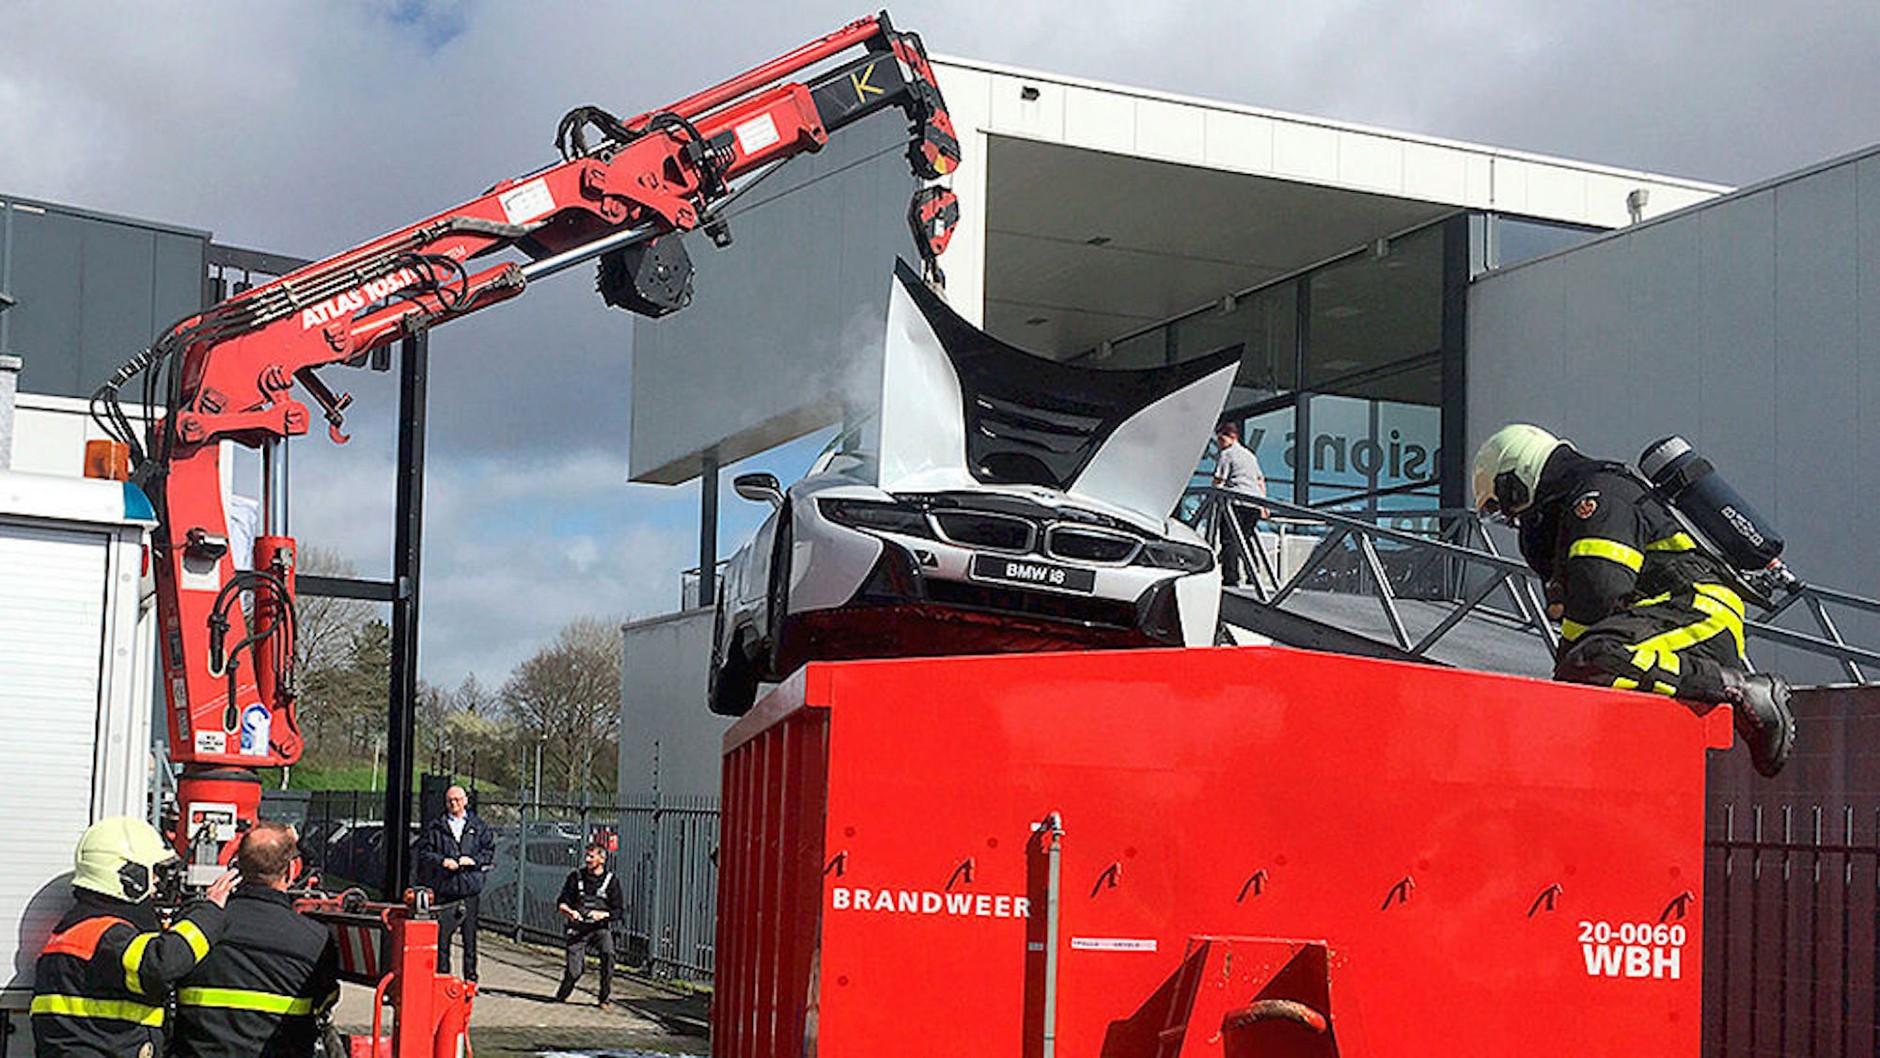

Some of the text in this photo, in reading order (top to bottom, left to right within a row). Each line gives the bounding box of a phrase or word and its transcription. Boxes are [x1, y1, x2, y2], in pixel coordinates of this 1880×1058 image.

[850, 63, 885, 104] K
[302, 290, 364, 329] ATLAS
[1006, 563, 1066, 585] BMW i8
[832, 887, 1031, 918] BRANDWEER
[1577, 920, 1686, 946] 20-0060
[1582, 943, 1681, 979] WBH
